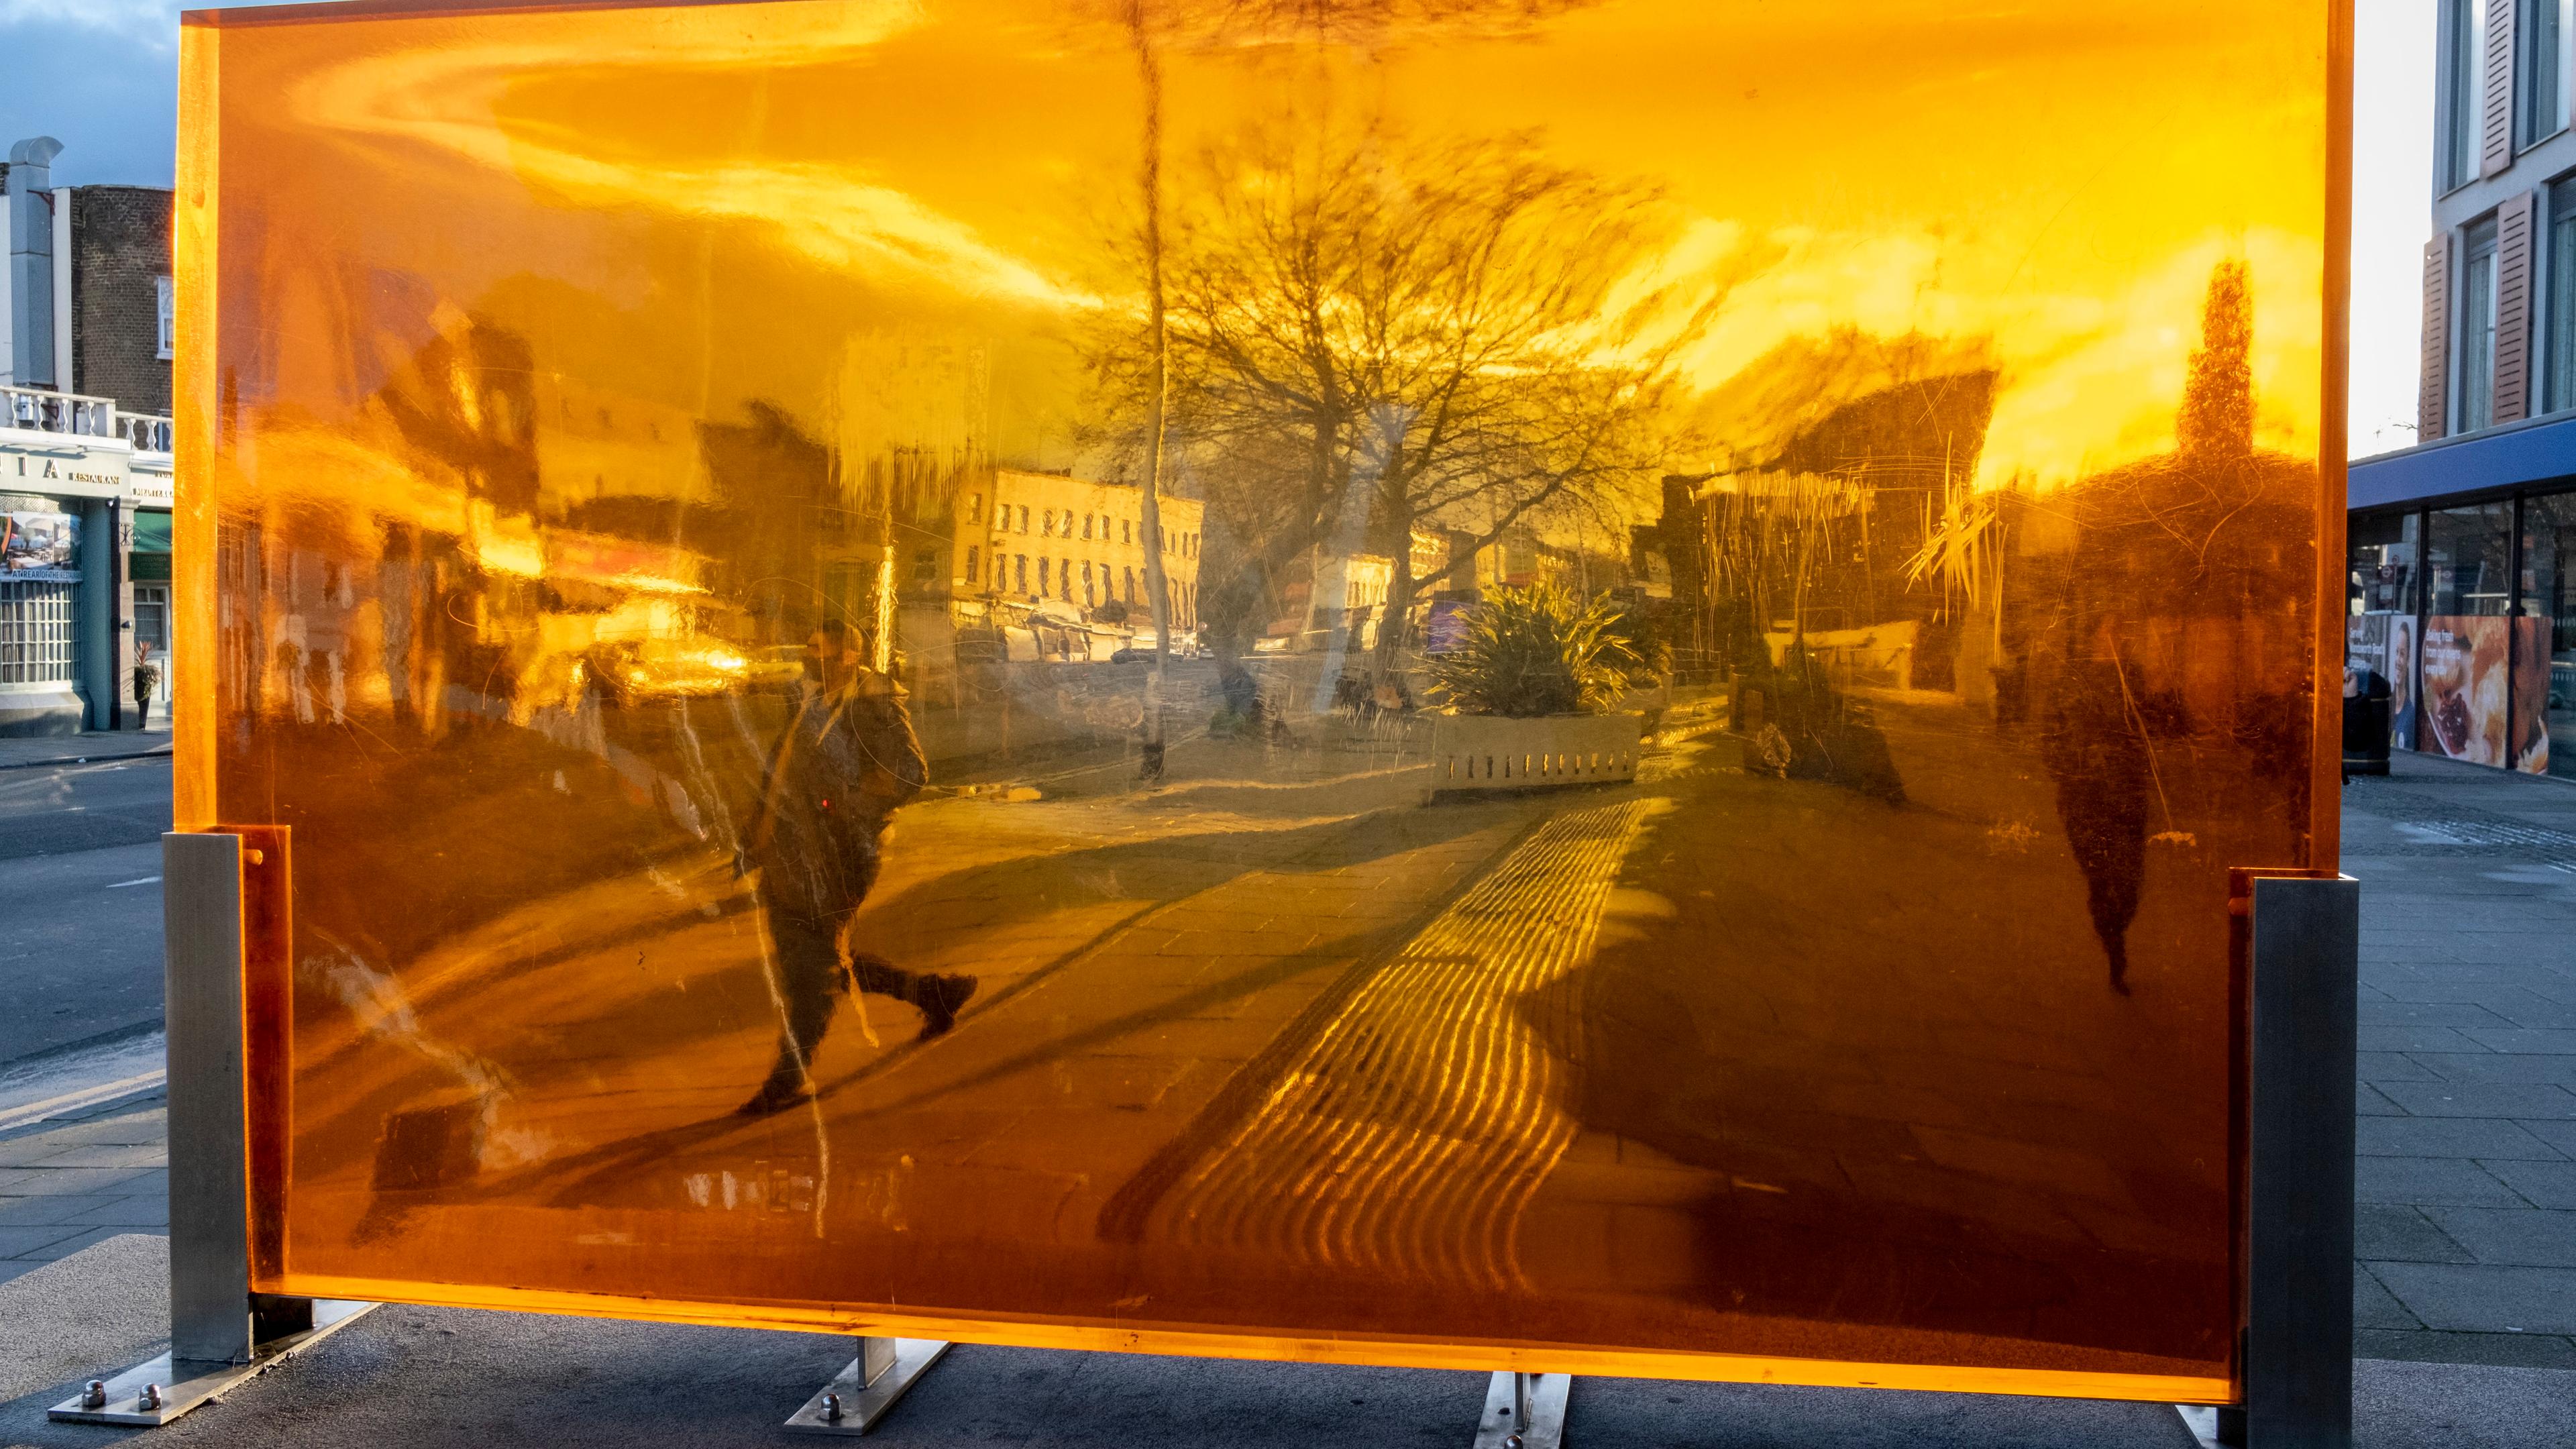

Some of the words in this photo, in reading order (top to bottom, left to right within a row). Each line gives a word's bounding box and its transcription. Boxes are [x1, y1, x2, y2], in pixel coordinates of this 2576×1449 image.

[71, 472, 121, 484] RESTAURANT
[23, 570, 40, 578] REAR
[41, 570, 48, 578] OF
[50, 571, 59, 579] THE
